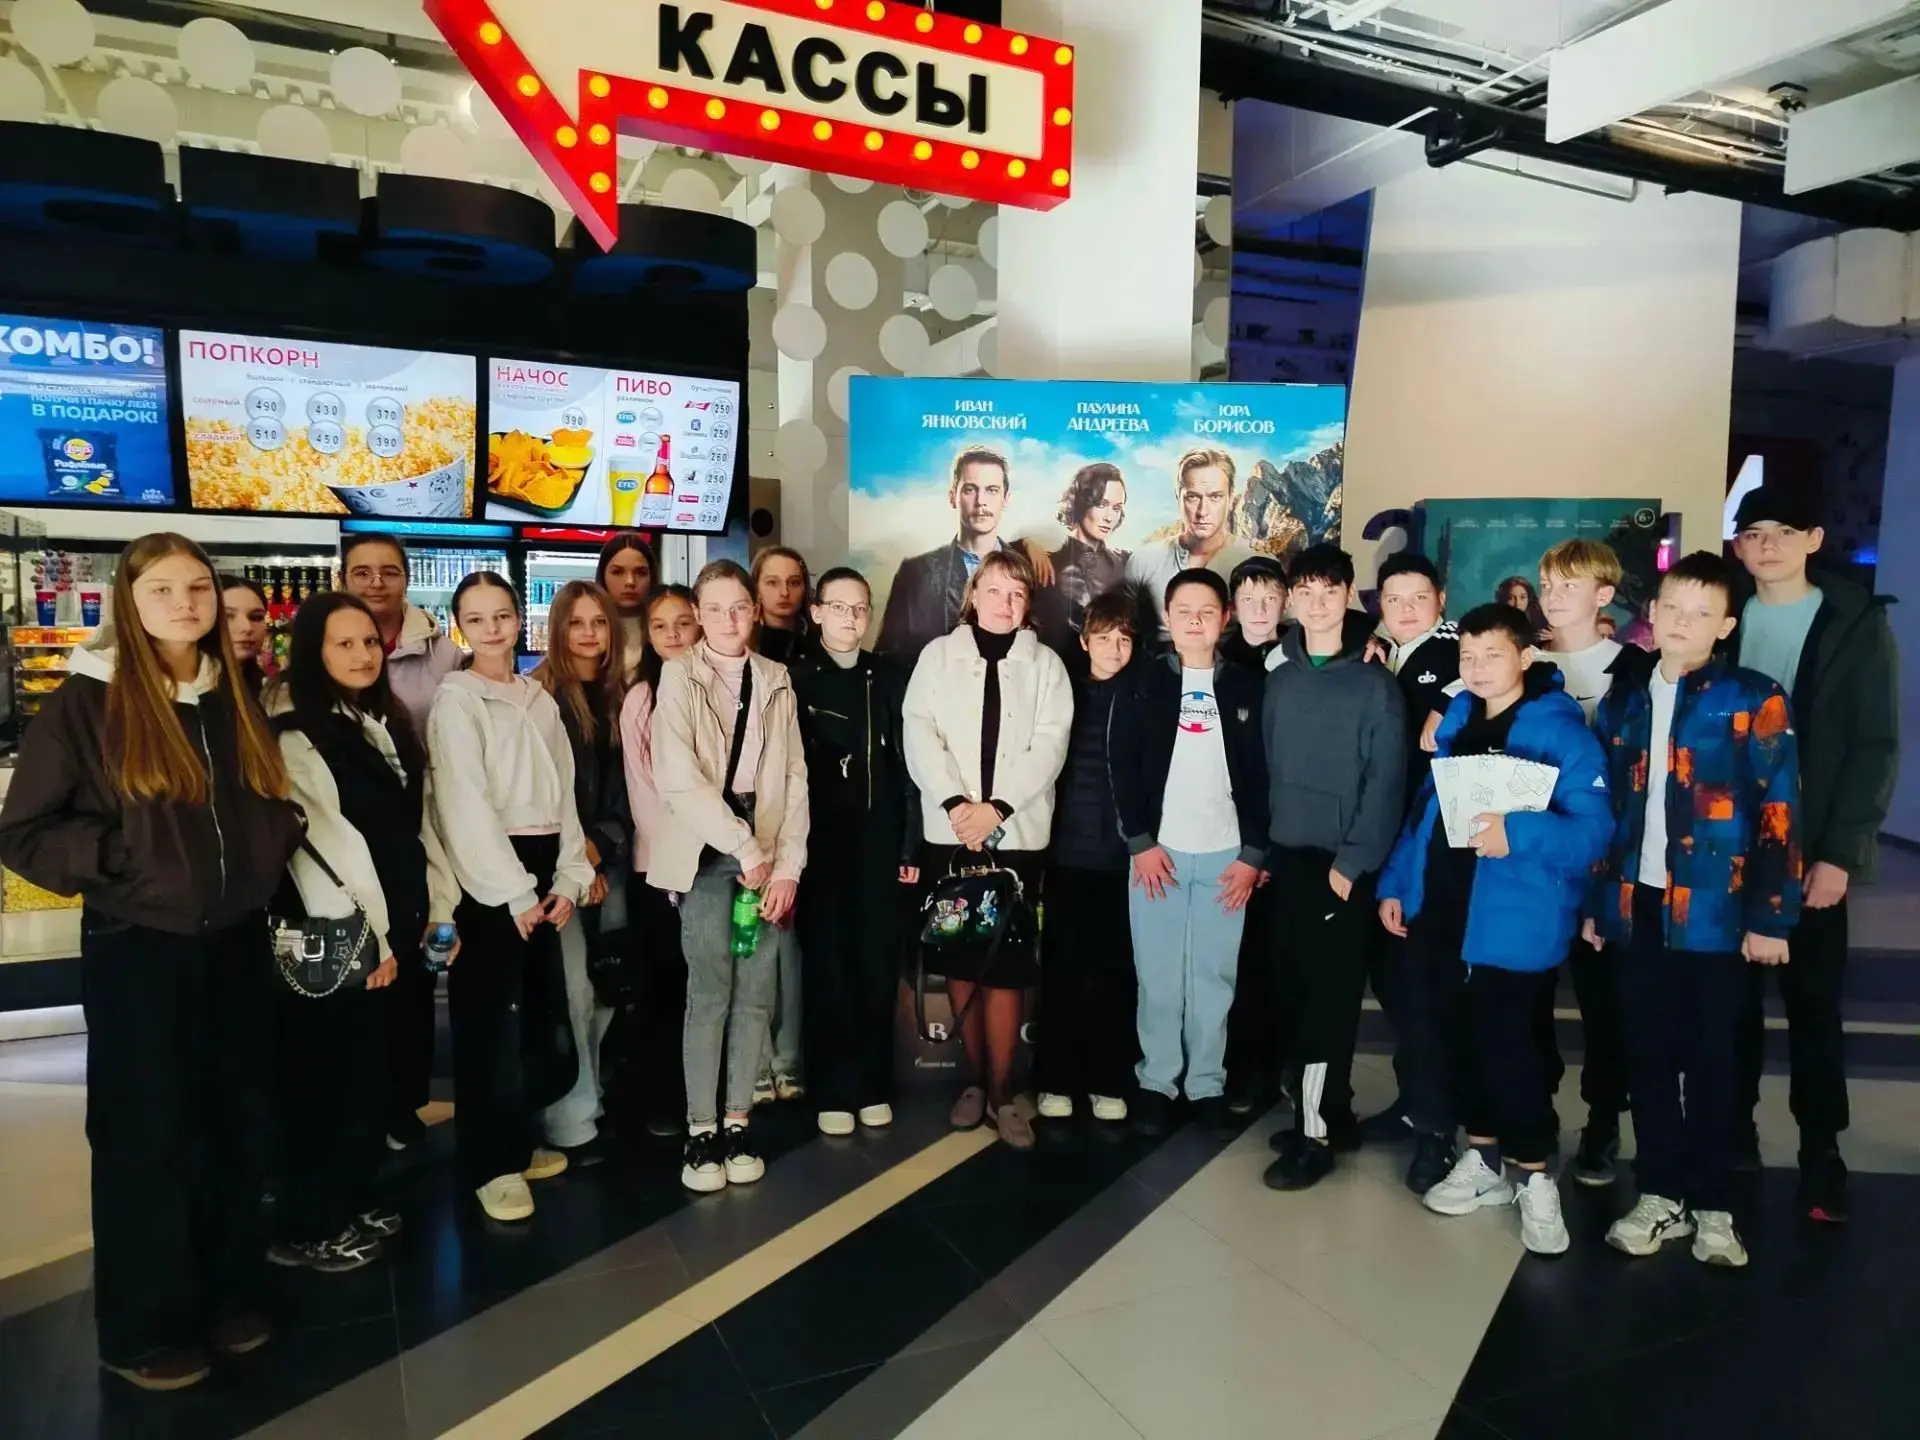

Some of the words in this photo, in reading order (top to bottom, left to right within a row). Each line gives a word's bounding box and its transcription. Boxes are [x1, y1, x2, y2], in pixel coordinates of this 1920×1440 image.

[658, 3, 988, 134] КАССЫ
[189, 341, 320, 369] ПОПКОРН
[497, 365, 569, 387] НАЧОС
[616, 377, 672, 396] ПИВО
[31, 394, 78, 405] ПОЛУЧИ
[87, 397, 125, 408] ПАЧКУ
[255, 401, 278, 412] 490
[955, 399, 993, 412] ИВАН
[32, 403, 47, 417] В
[51, 405, 158, 424] ПОДАРОК!
[315, 404, 338, 416] 430
[376, 409, 397, 421] 370
[714, 403, 730, 414] 250
[1077, 402, 1141, 415] ПАУЛИНА
[1218, 404, 1251, 417] ЮРА
[564, 414, 584, 426] 390
[922, 413, 1028, 431] ЯНКОВСКИЙ
[1067, 417, 1150, 432] АНДРЕЕВА
[1193, 419, 1276, 434] БОРИСОВ
[255, 429, 278, 441] 510
[315, 433, 339, 446] 450
[713, 428, 729, 439] 250
[376, 437, 398, 448] 390
[711, 452, 727, 462] 260
[707, 475, 724, 484] 250
[704, 495, 721, 504] 230
[701, 514, 718, 523] 230
